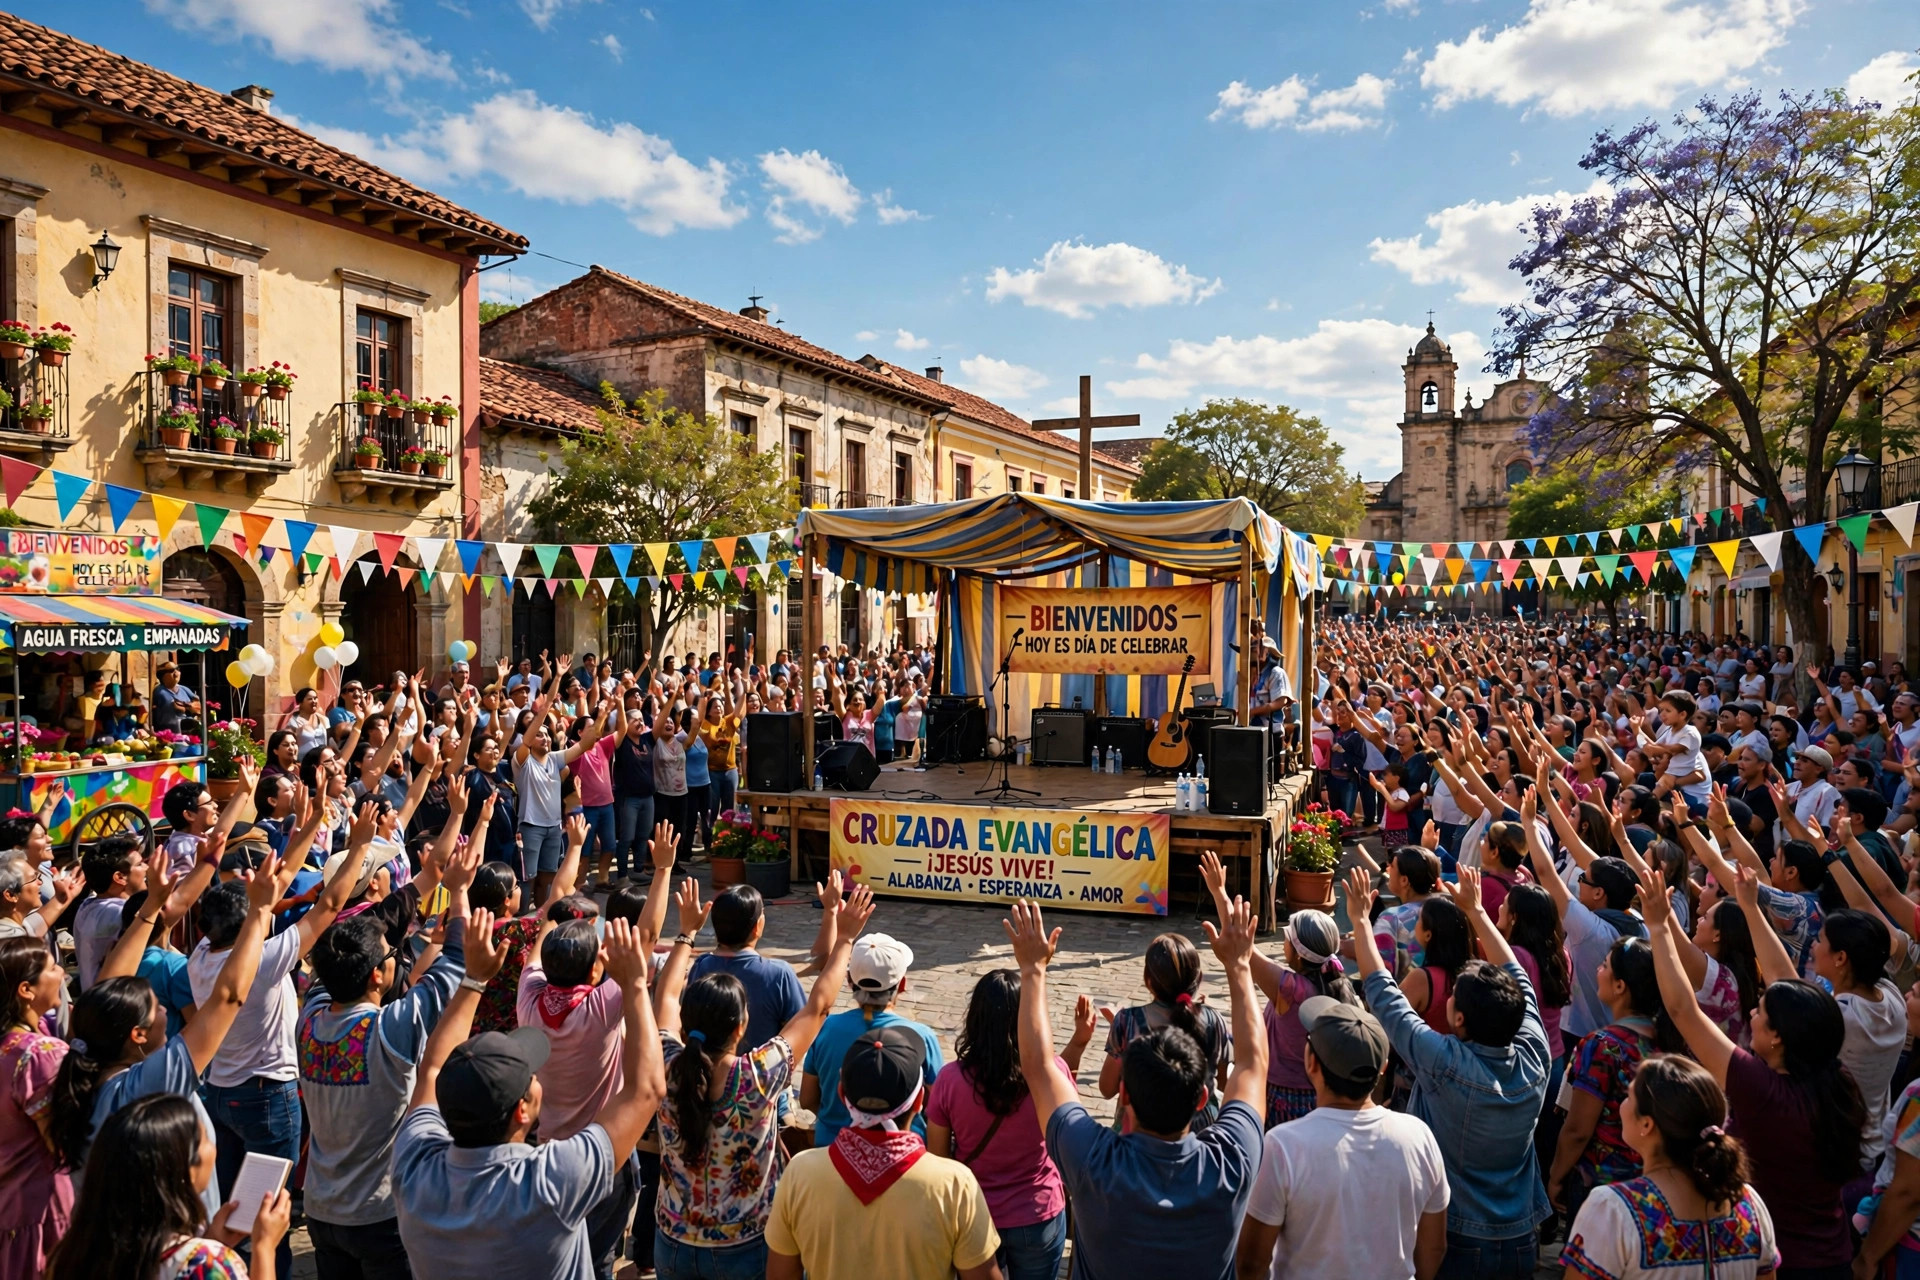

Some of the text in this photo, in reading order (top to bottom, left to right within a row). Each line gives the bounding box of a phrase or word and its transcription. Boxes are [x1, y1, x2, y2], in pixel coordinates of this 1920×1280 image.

[17, 532, 128, 554] BIENVENIDOS
[73, 564, 94, 575] HOY
[99, 564, 111, 574] ES
[1030, 604, 1178, 632] BIENVENIDOS
[22, 628, 220, 647] AGUA FRESCA EMPANADAS
[1025, 634, 1188, 654] HOY ES DÍA DE CELEBRAR
[842, 812, 1156, 861] CRUZADA EVANGÉLICA
[927, 852, 1054, 880] ¡JESÚS VIVE!
[888, 872, 1123, 904] ALABANZA ESPERANZA AMOR
